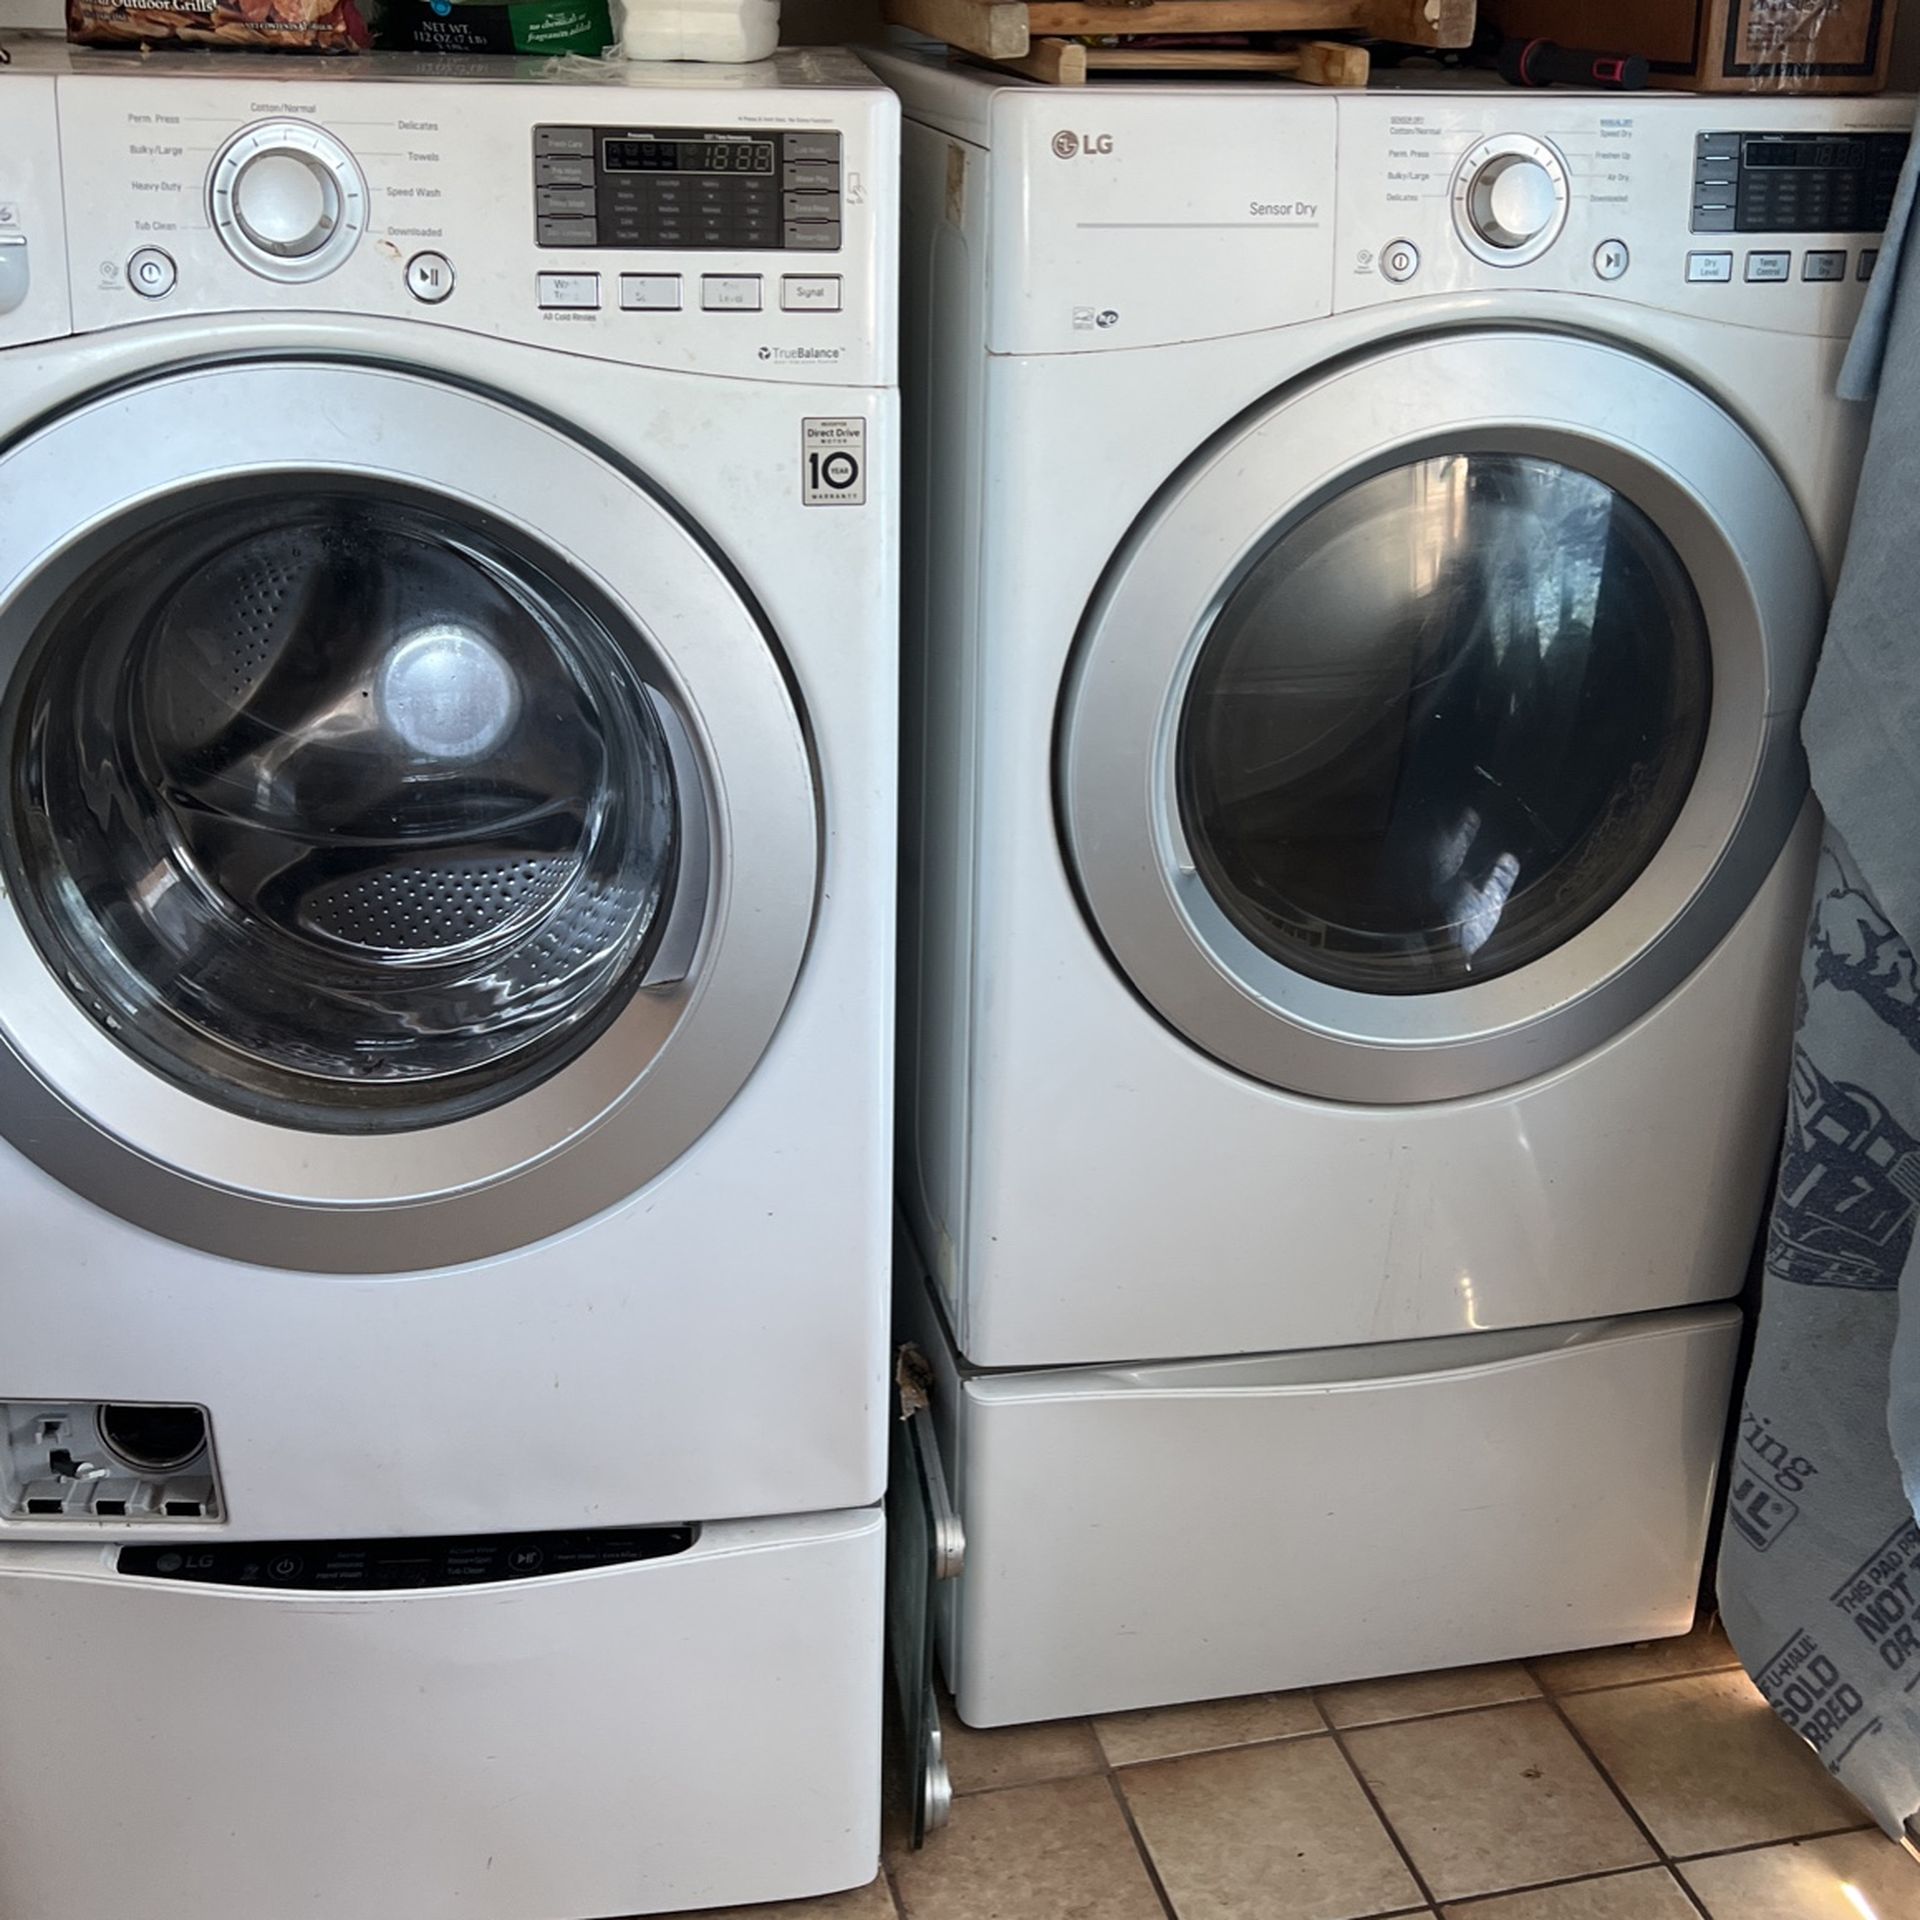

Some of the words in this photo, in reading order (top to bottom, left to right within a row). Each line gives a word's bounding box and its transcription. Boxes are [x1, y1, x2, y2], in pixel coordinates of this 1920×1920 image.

[422, 21, 446, 32] NET
[250, 103, 317, 114] Cotton/Normal
[128, 114, 152, 124] Perm.
[155, 115, 180, 124] Press
[398, 120, 439, 131] Delicates
[1389, 127, 1442, 135] Cotton/Normal
[1083, 134, 1113, 155] LG
[130, 145, 183, 157] Bulky/Large
[1410, 150, 1430, 158] Press
[408, 152, 440, 162] Towels
[1387, 172, 1430, 181] Bulky/Large
[131, 182, 160, 193] Heavy
[161, 182, 182, 193] Duty
[387, 187, 413, 198] Speed
[416, 187, 441, 198] Wash
[1249, 201, 1291, 216] Sensor
[1295, 202, 1318, 218] Dry
[135, 220, 150, 230] Tub
[152, 221, 177, 231] Clean
[388, 227, 443, 238] Downloaded
[1704, 258, 1718, 268] Dry
[1700, 267, 1720, 277] Level
[1756, 267, 1781, 277] Control
[797, 287, 824, 299] Signal
[543, 313, 553, 321] All
[555, 313, 571, 321] Cold
[572, 313, 597, 322] Rinses
[807, 428, 834, 438] Direct
[835, 428, 861, 438] Drive
[809, 451, 859, 490] 10
[831, 467, 849, 475] YEAR
[185, 1554, 214, 1569] LG
[1836, 1579, 1875, 1614] THIS
[1867, 1551, 1904, 1586] PAD
[1855, 1572, 1915, 1644] NOT
[1879, 1623, 1920, 1671] OR
[1771, 1654, 1840, 1727] SOLD
